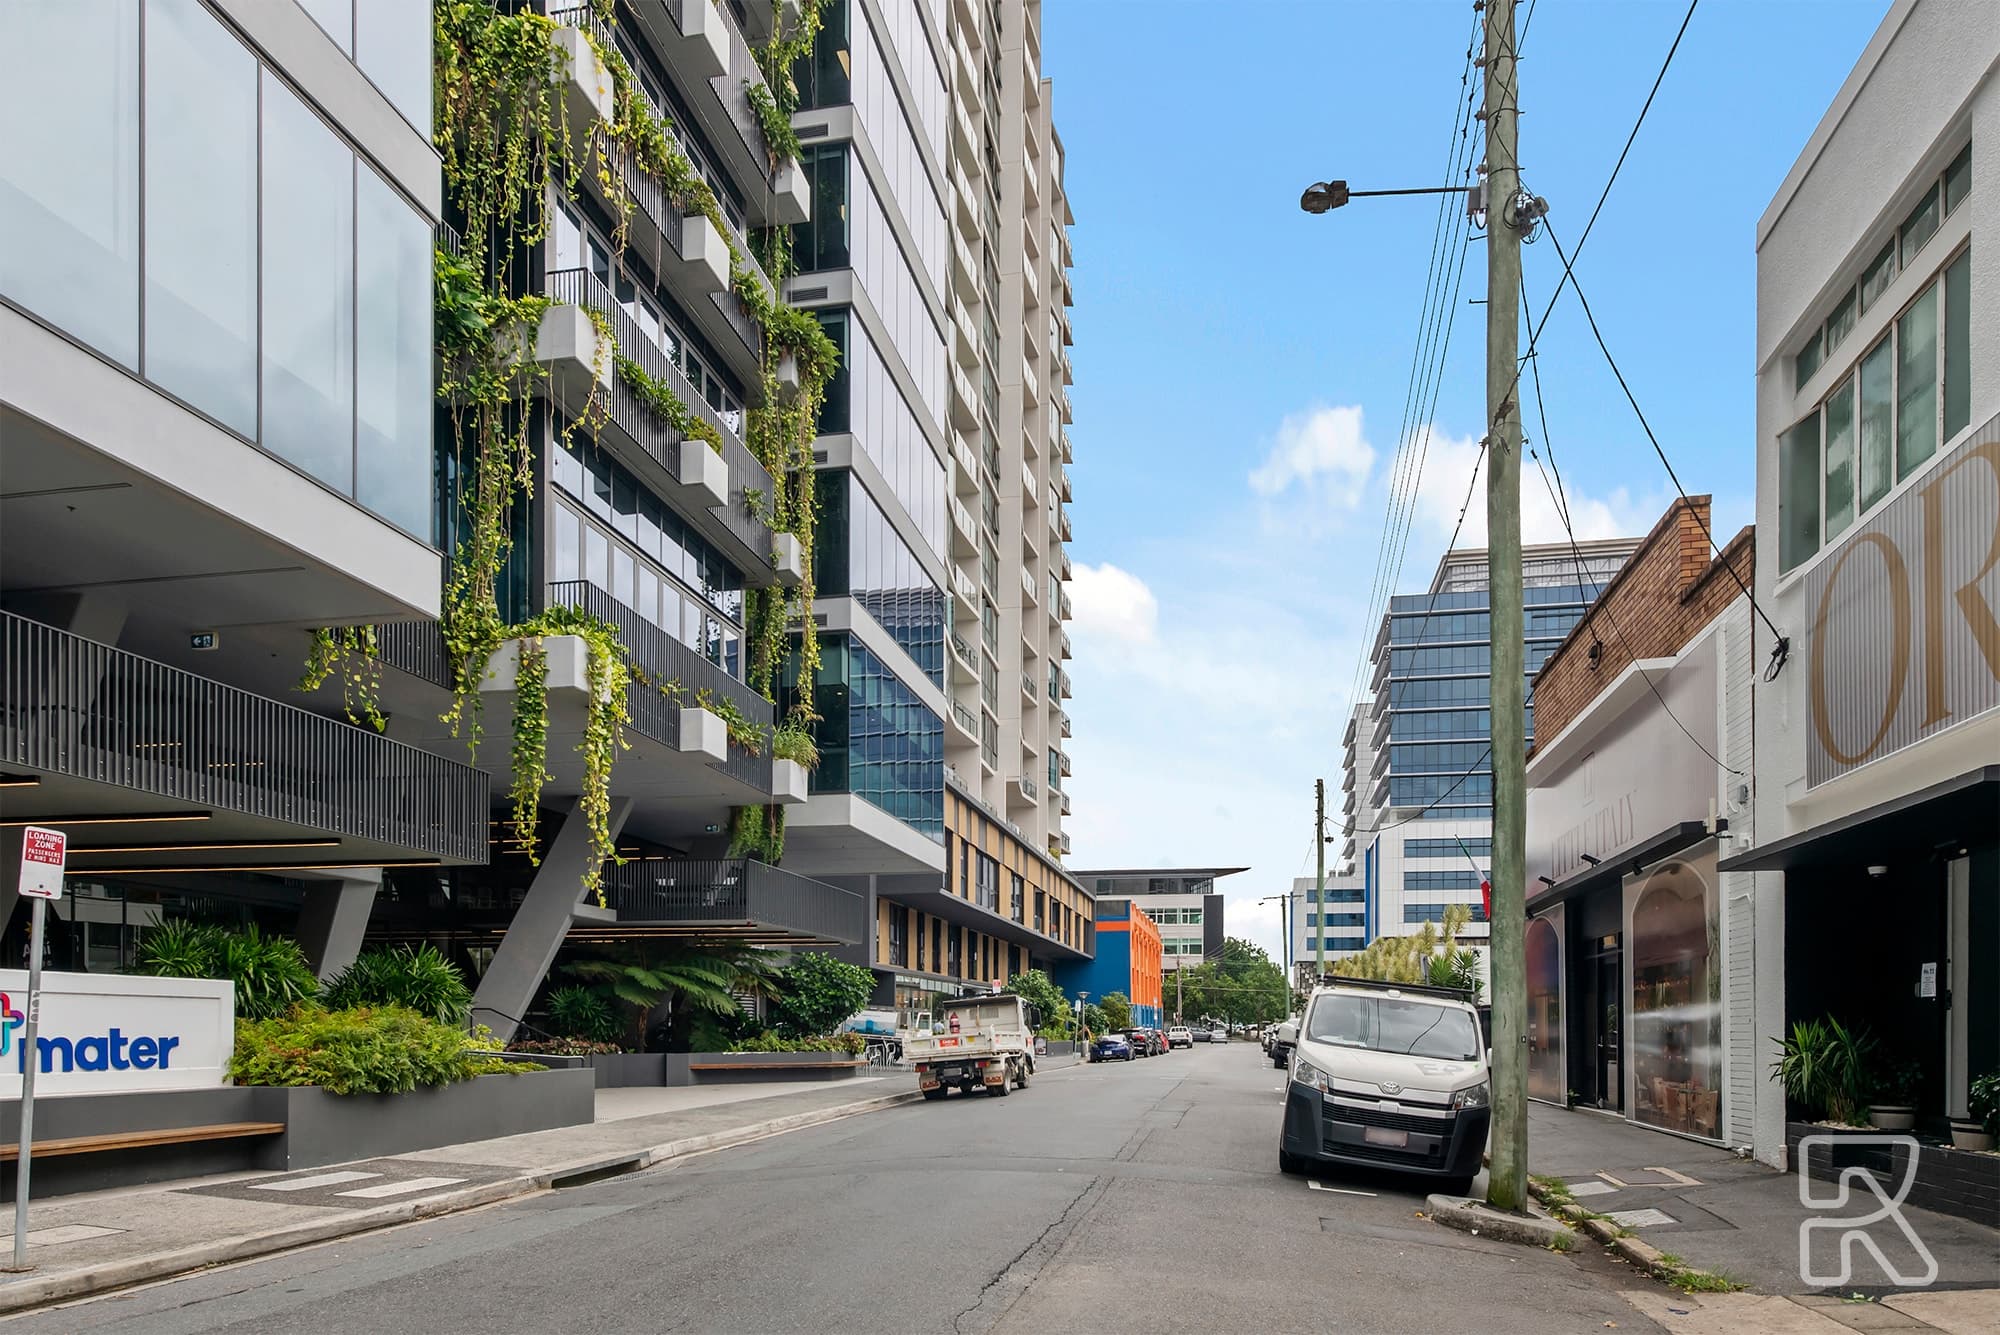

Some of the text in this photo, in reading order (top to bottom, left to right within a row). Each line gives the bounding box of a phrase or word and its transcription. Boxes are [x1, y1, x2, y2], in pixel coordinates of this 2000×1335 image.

[1809, 441, 2000, 765] OR
[1595, 789, 1637, 857] ITALY
[29, 832, 62, 844] LOADING
[34, 840, 56, 850] ZONE
[28, 848, 61, 858] PASSENGERS
[18, 1028, 179, 1074] mater
